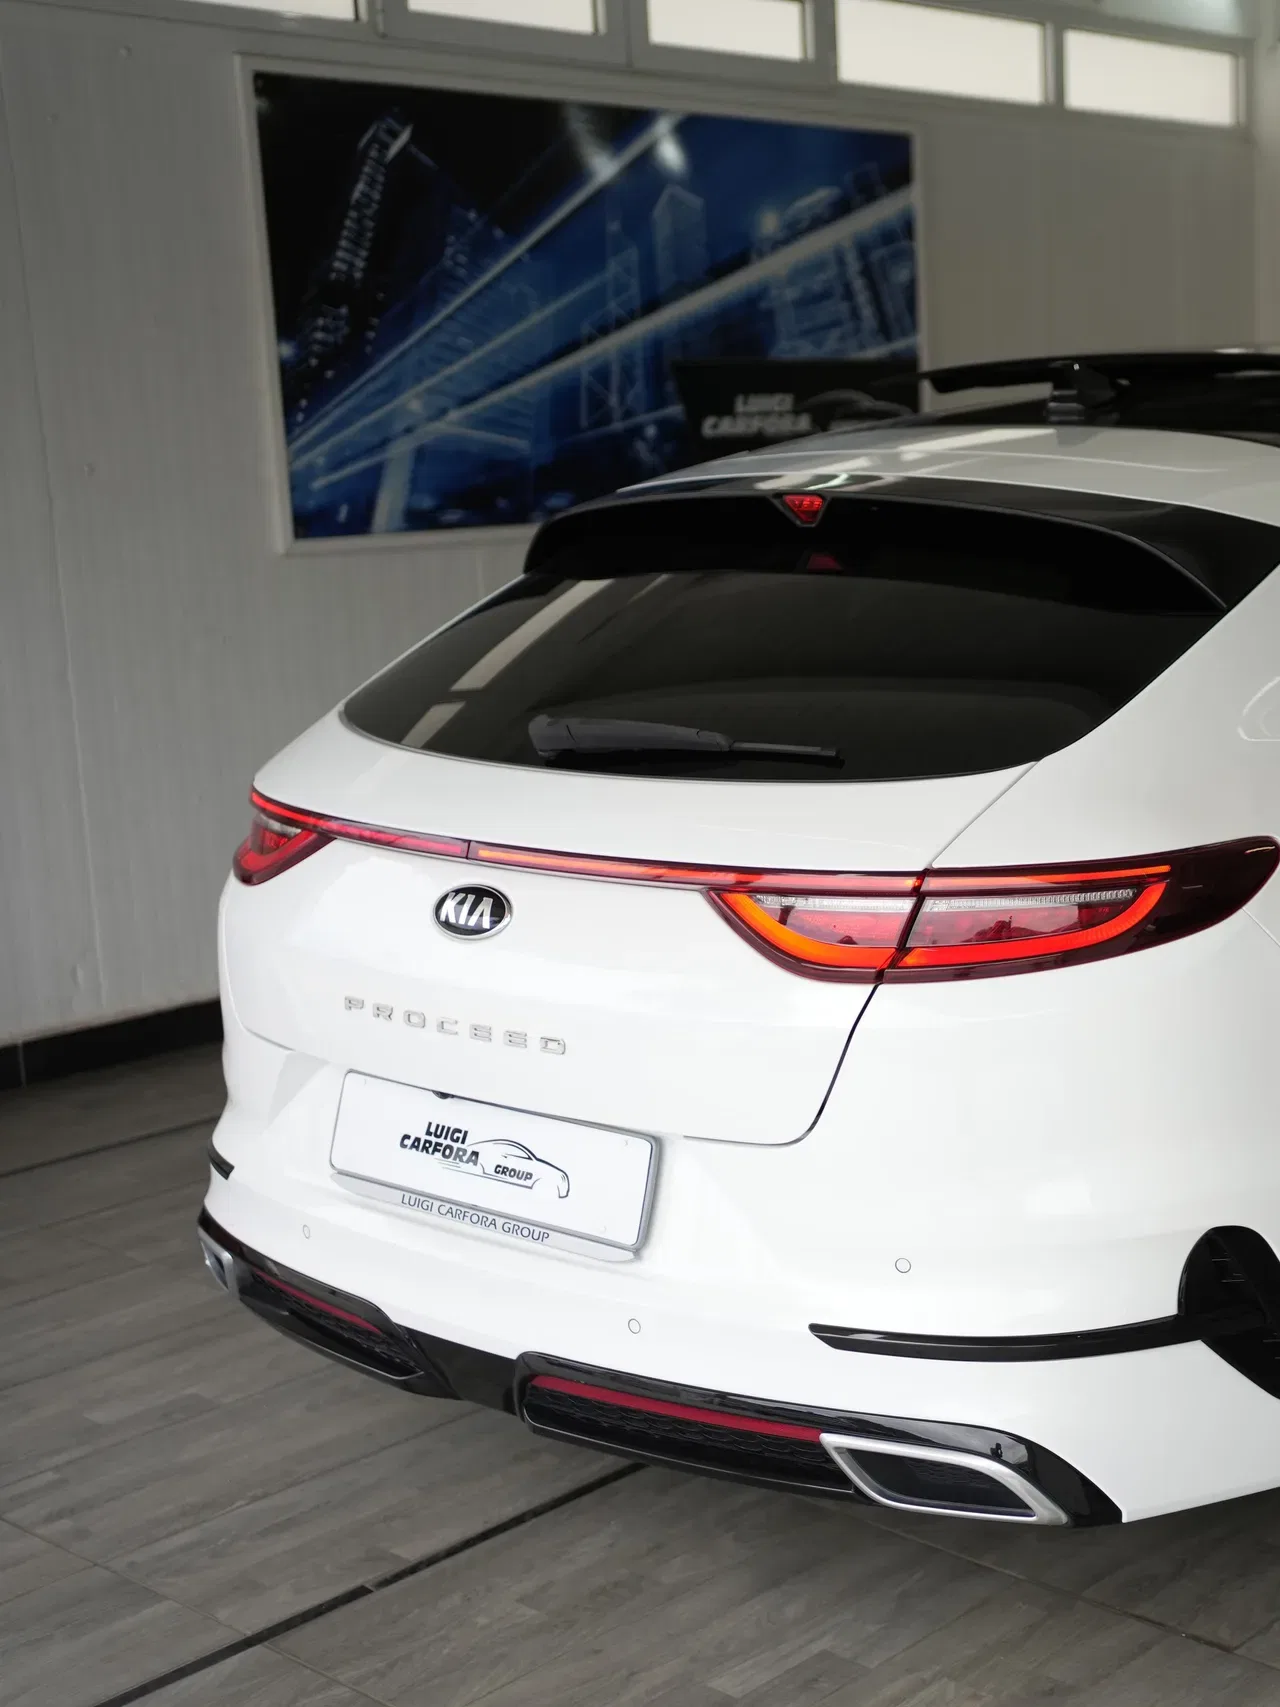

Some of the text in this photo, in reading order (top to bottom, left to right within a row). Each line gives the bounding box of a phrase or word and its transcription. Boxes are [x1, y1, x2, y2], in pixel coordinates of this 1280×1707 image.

[439, 891, 494, 929] KIA
[344, 996, 566, 1055] PROCEED
[399, 1133, 480, 1167] CARFORA
[425, 1121, 469, 1145] LUIGI
[493, 1164, 533, 1182] GROUP
[401, 1193, 550, 1244] LUIGI CARFORA GROUP
